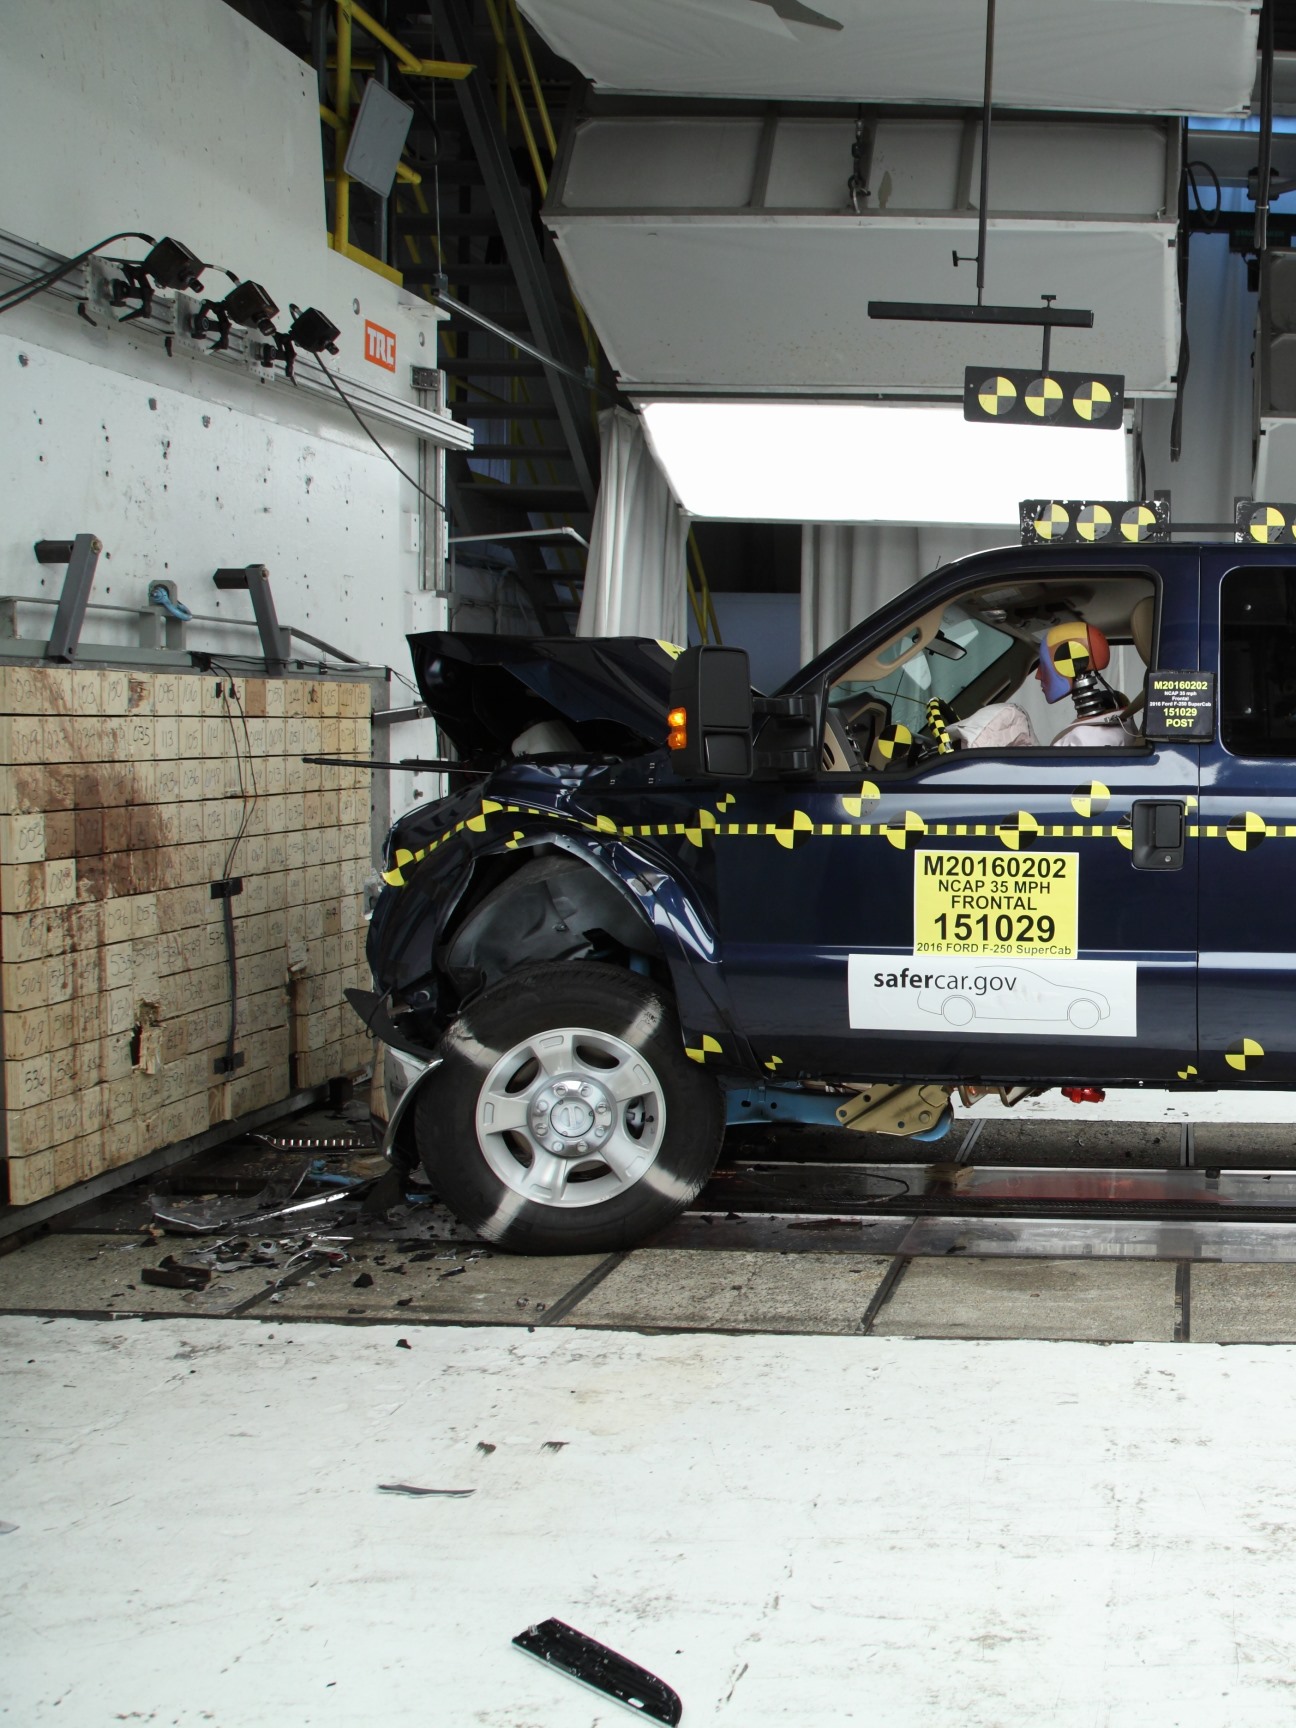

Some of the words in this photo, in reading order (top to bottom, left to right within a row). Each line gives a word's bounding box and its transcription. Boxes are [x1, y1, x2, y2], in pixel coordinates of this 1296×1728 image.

[1154, 681, 1208, 690] M20160202
[1163, 708, 1198, 717] 151029
[1165, 719, 1195, 728] POST
[133, 725, 151, 746] 035
[161, 730, 174, 748] 113
[924, 856, 1066, 879] M20160202
[938, 879, 985, 893] NCAP
[990, 880, 1009, 894] 35
[1014, 881, 1051, 894] MPH
[951, 895, 1037, 911] FRONTAL
[934, 913, 1055, 942] 151029
[917, 943, 943, 952] 2016
[946, 943, 979, 953] FORD
[982, 944, 1013, 954] F-250
[1016, 945, 1072, 957] SuperCab
[873, 967, 1017, 996] safercar.gov
[25, 1067, 46, 1092] 536
